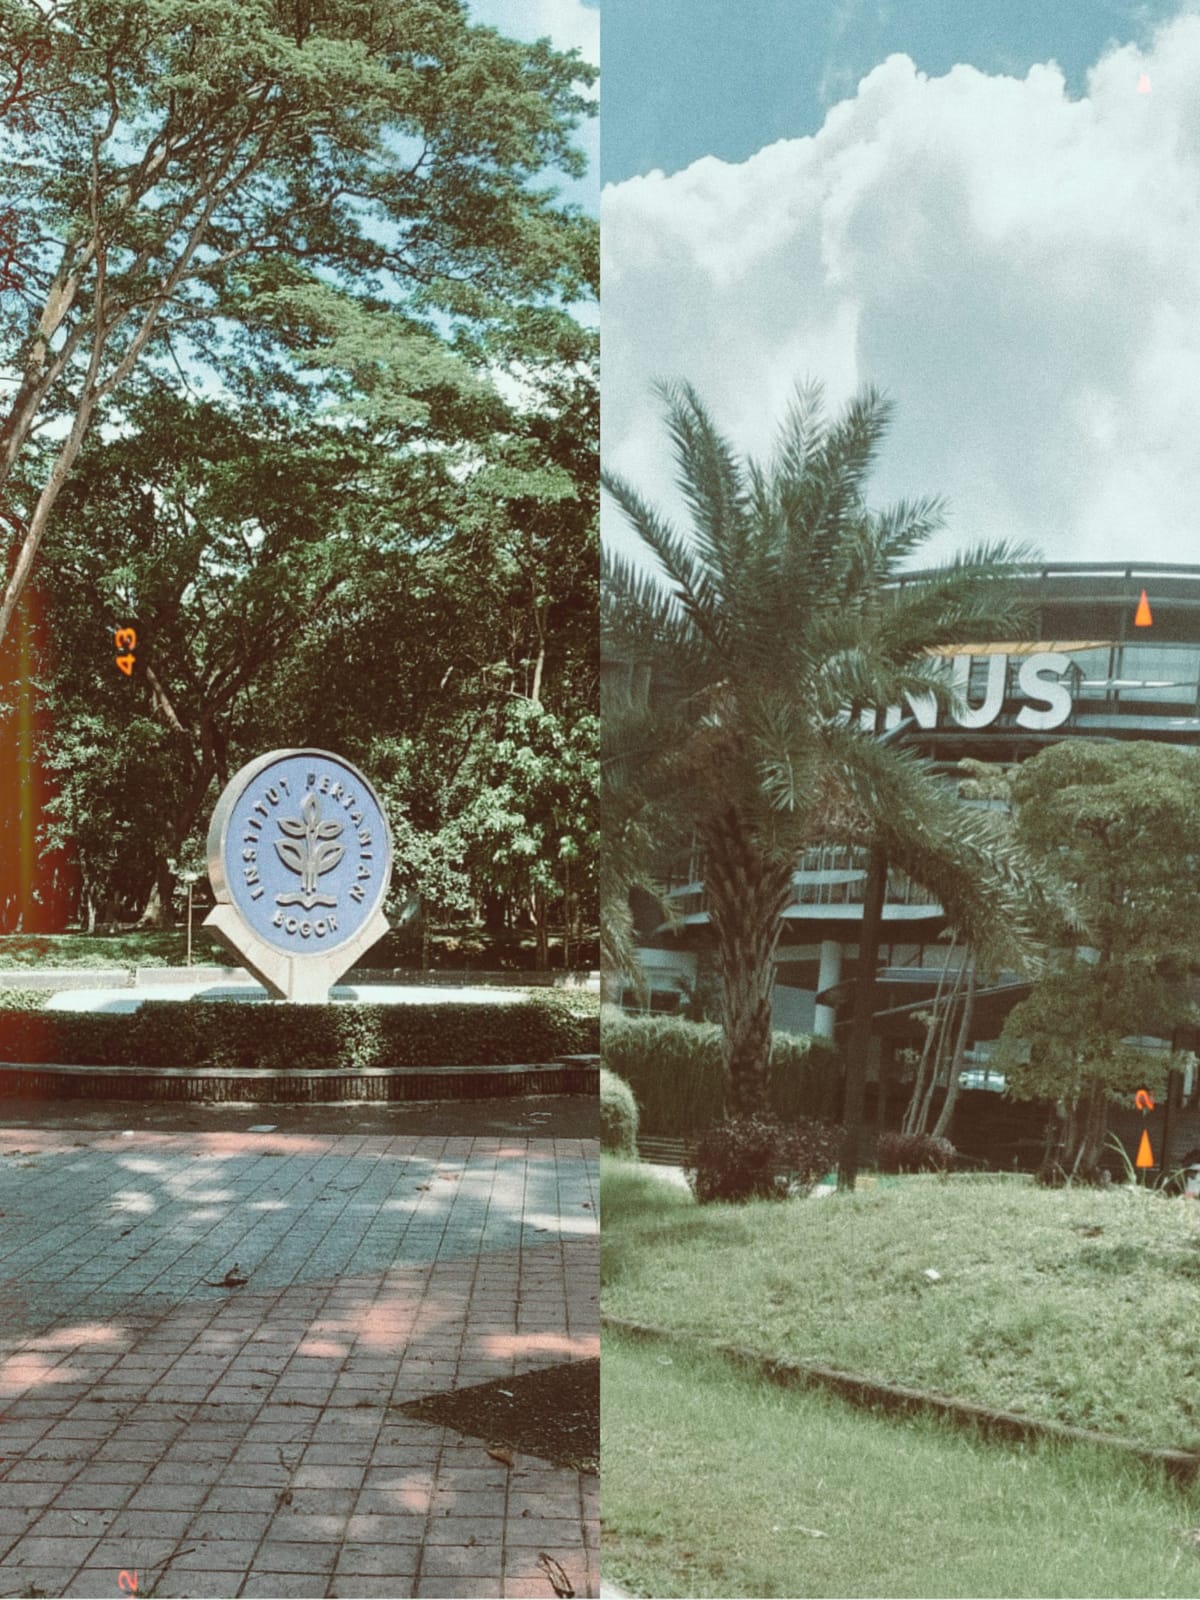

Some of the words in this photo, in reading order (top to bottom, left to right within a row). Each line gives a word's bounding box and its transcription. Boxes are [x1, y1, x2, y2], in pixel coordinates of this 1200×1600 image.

[242, 777, 290, 901] INSTITUT
[306, 773, 373, 903] PERTANIAN
[273, 909, 339, 938] BOGOR
